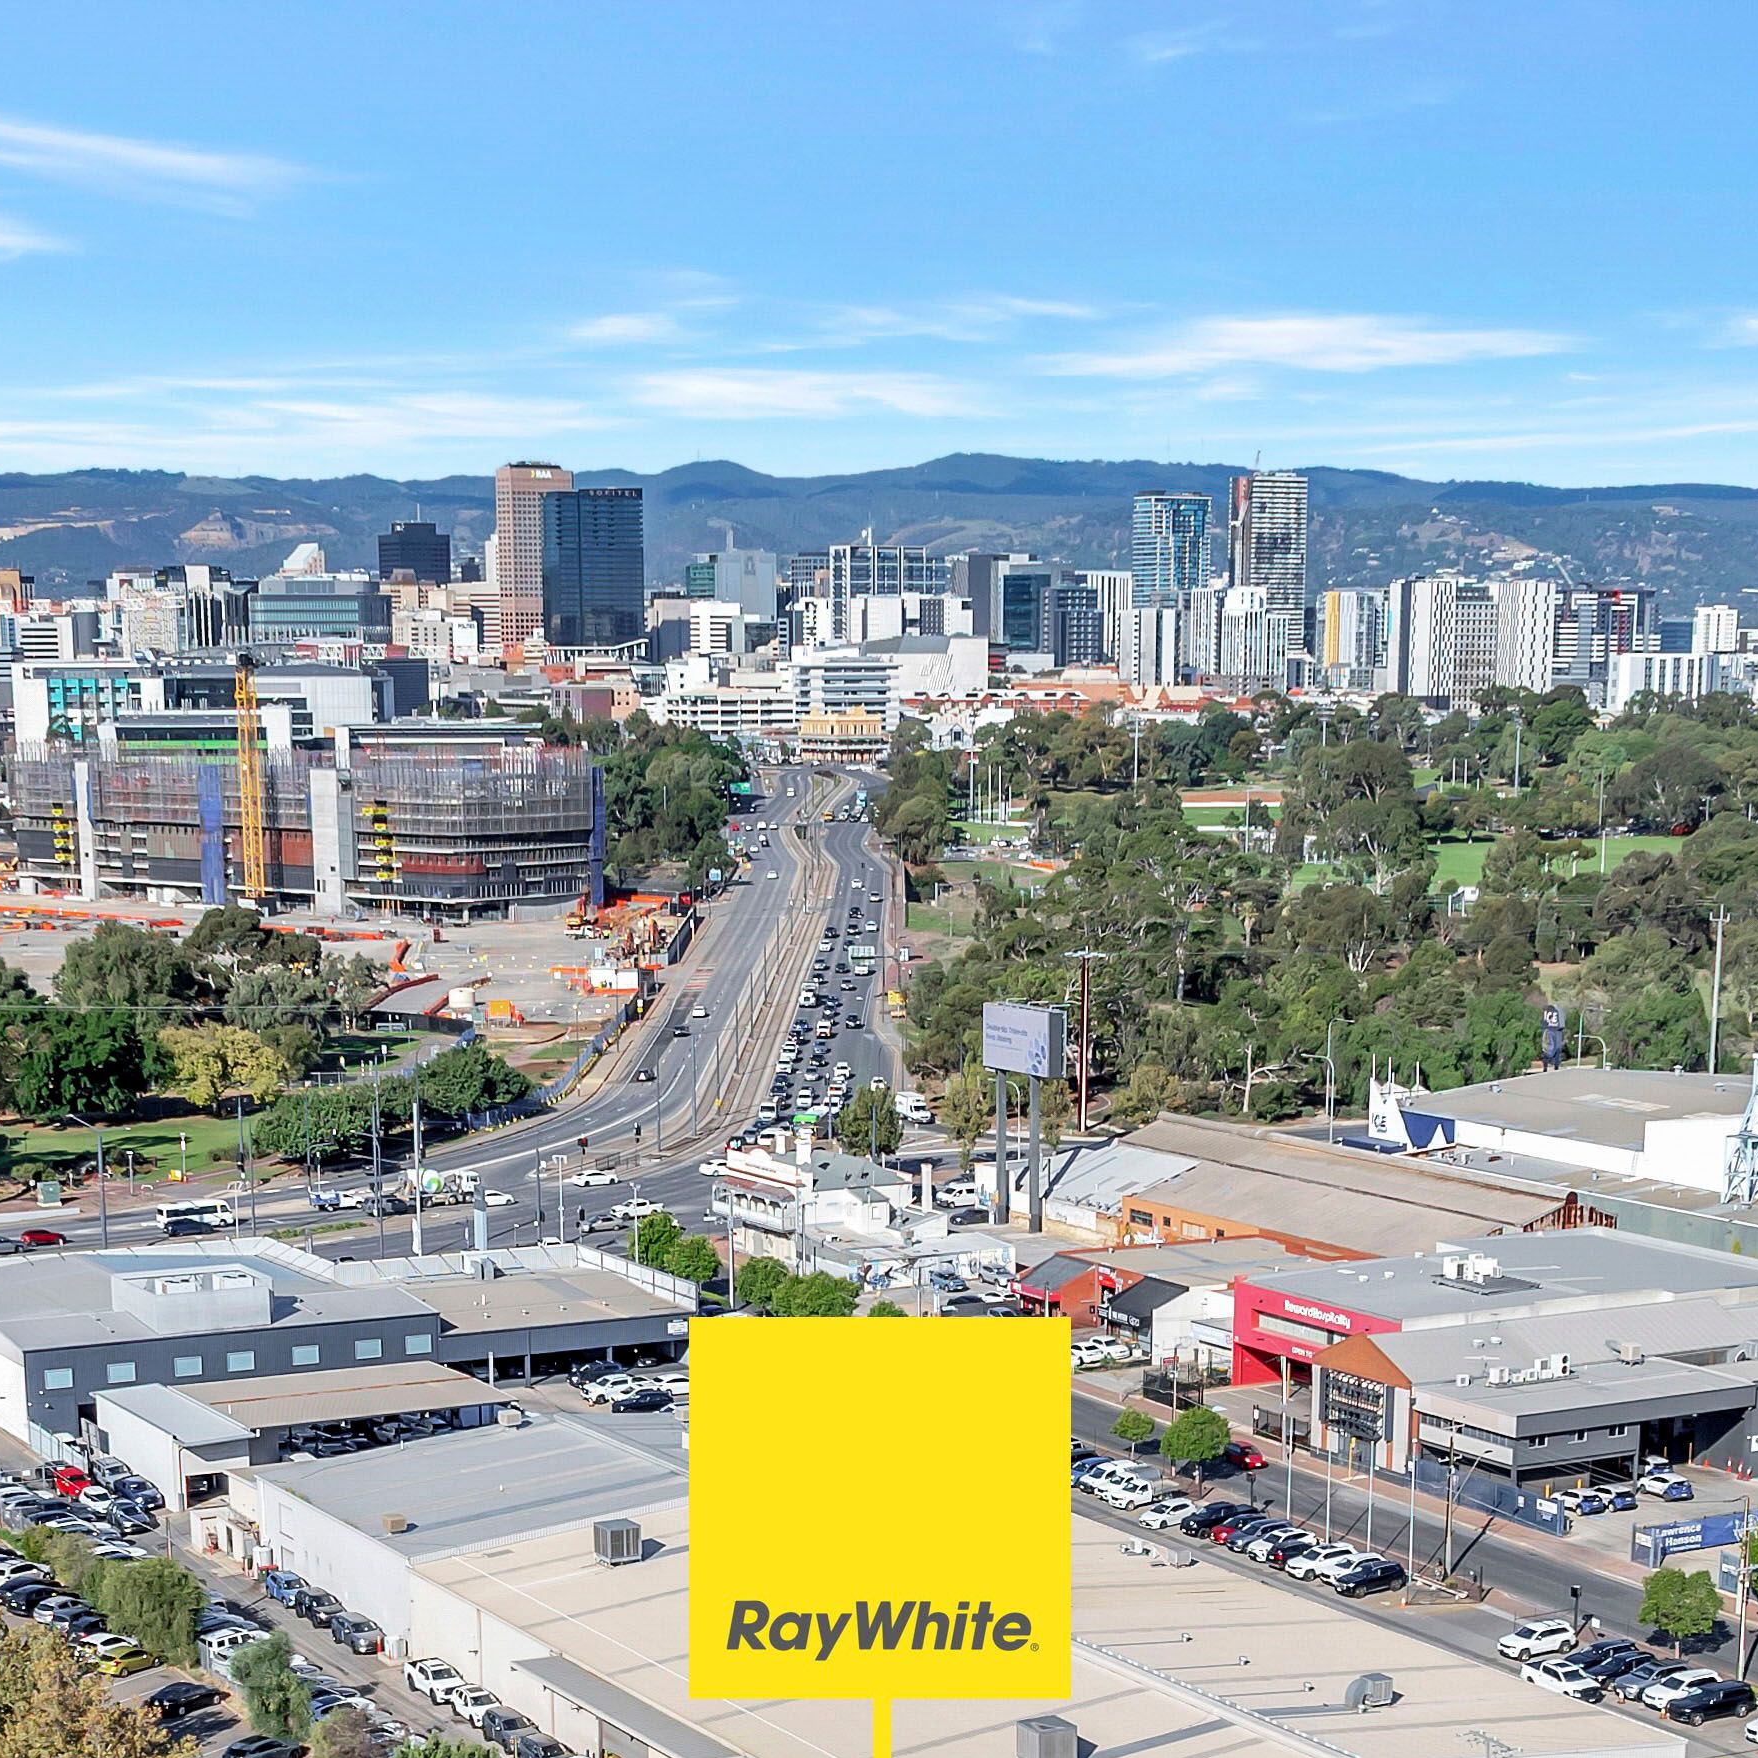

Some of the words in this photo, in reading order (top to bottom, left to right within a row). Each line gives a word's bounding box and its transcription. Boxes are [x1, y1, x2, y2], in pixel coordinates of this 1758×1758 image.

[588, 489, 638, 497] SOFITEL
[1655, 1523, 1702, 1537] Lawrence
[1665, 1534, 1702, 1546] Hanson
